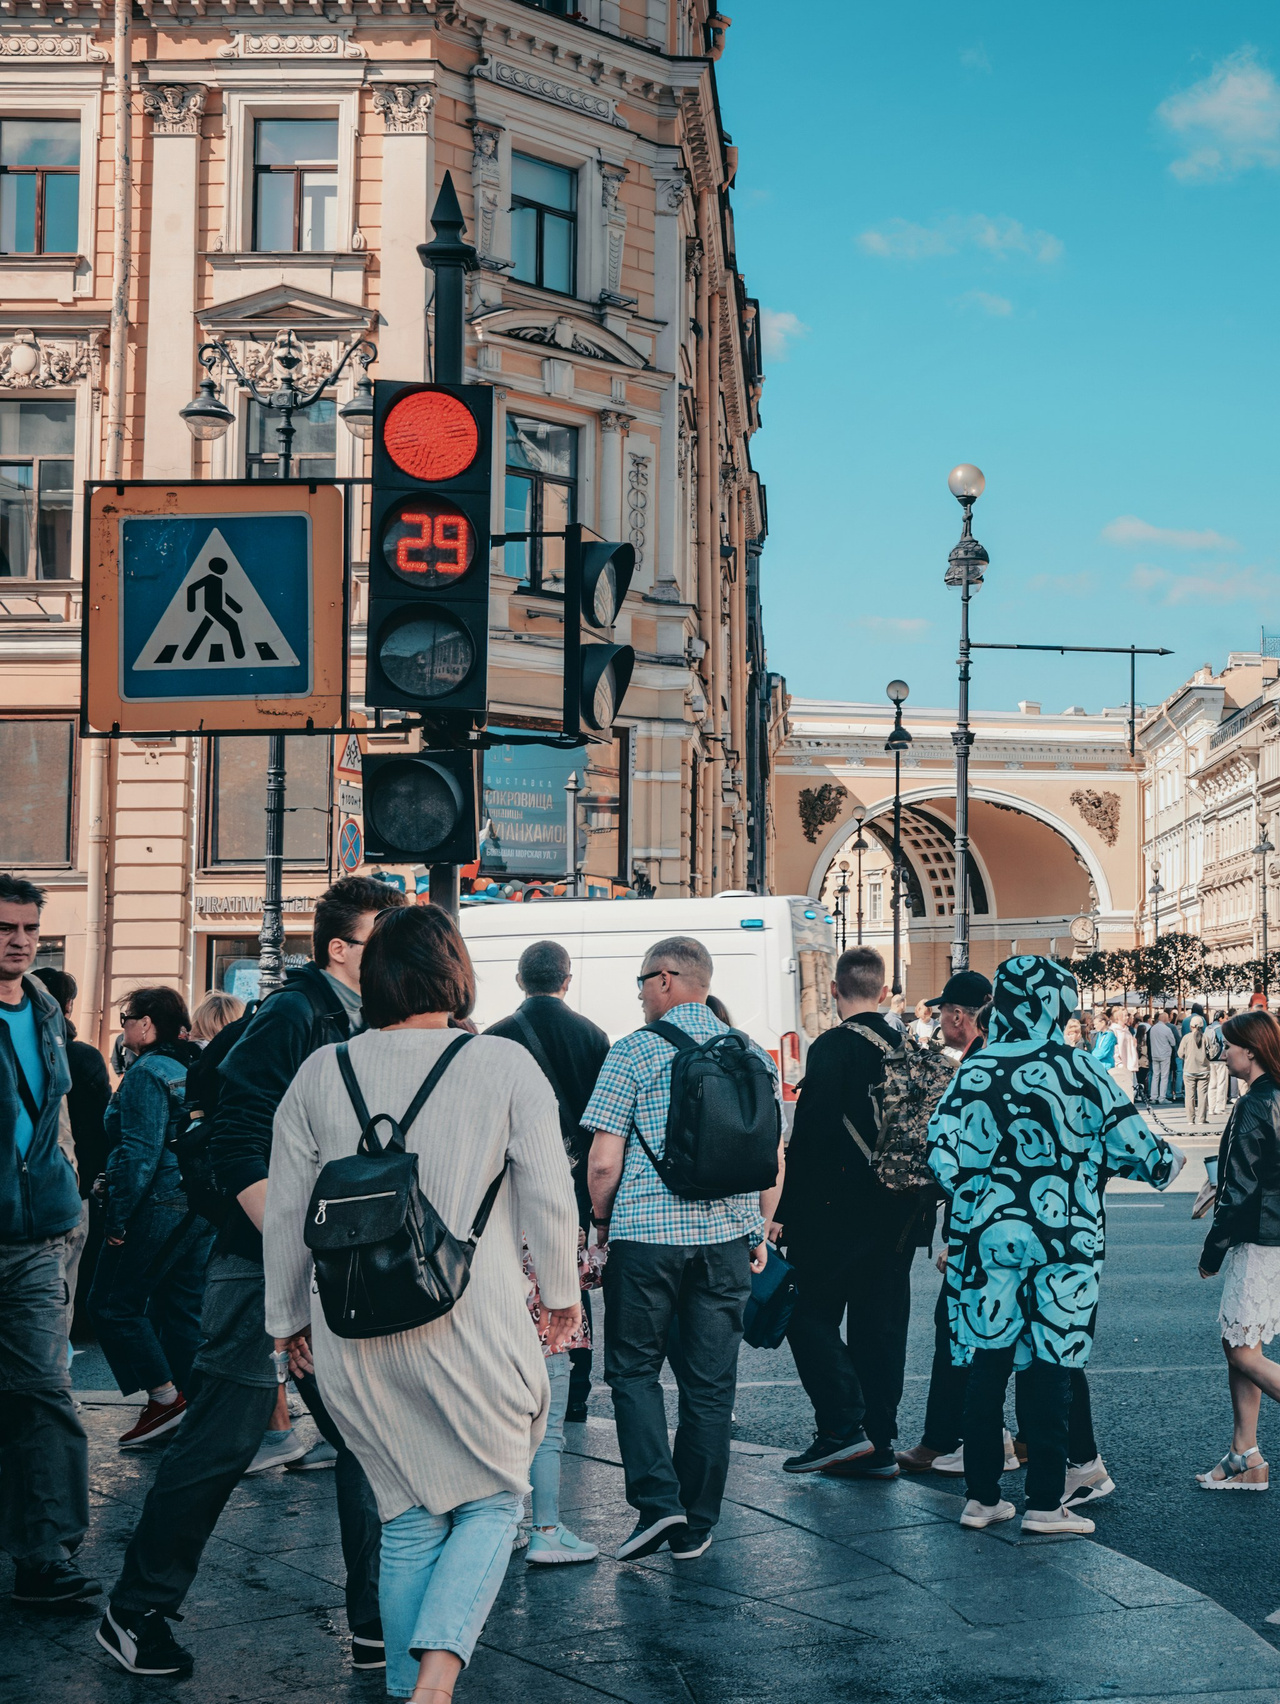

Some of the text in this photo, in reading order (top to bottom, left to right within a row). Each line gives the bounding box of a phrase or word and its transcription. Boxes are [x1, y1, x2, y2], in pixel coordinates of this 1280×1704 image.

[396, 512, 468, 573] 29
[487, 775, 552, 788] ВЫСТАВКА
[485, 789, 553, 810] СОКРОВИЩА
